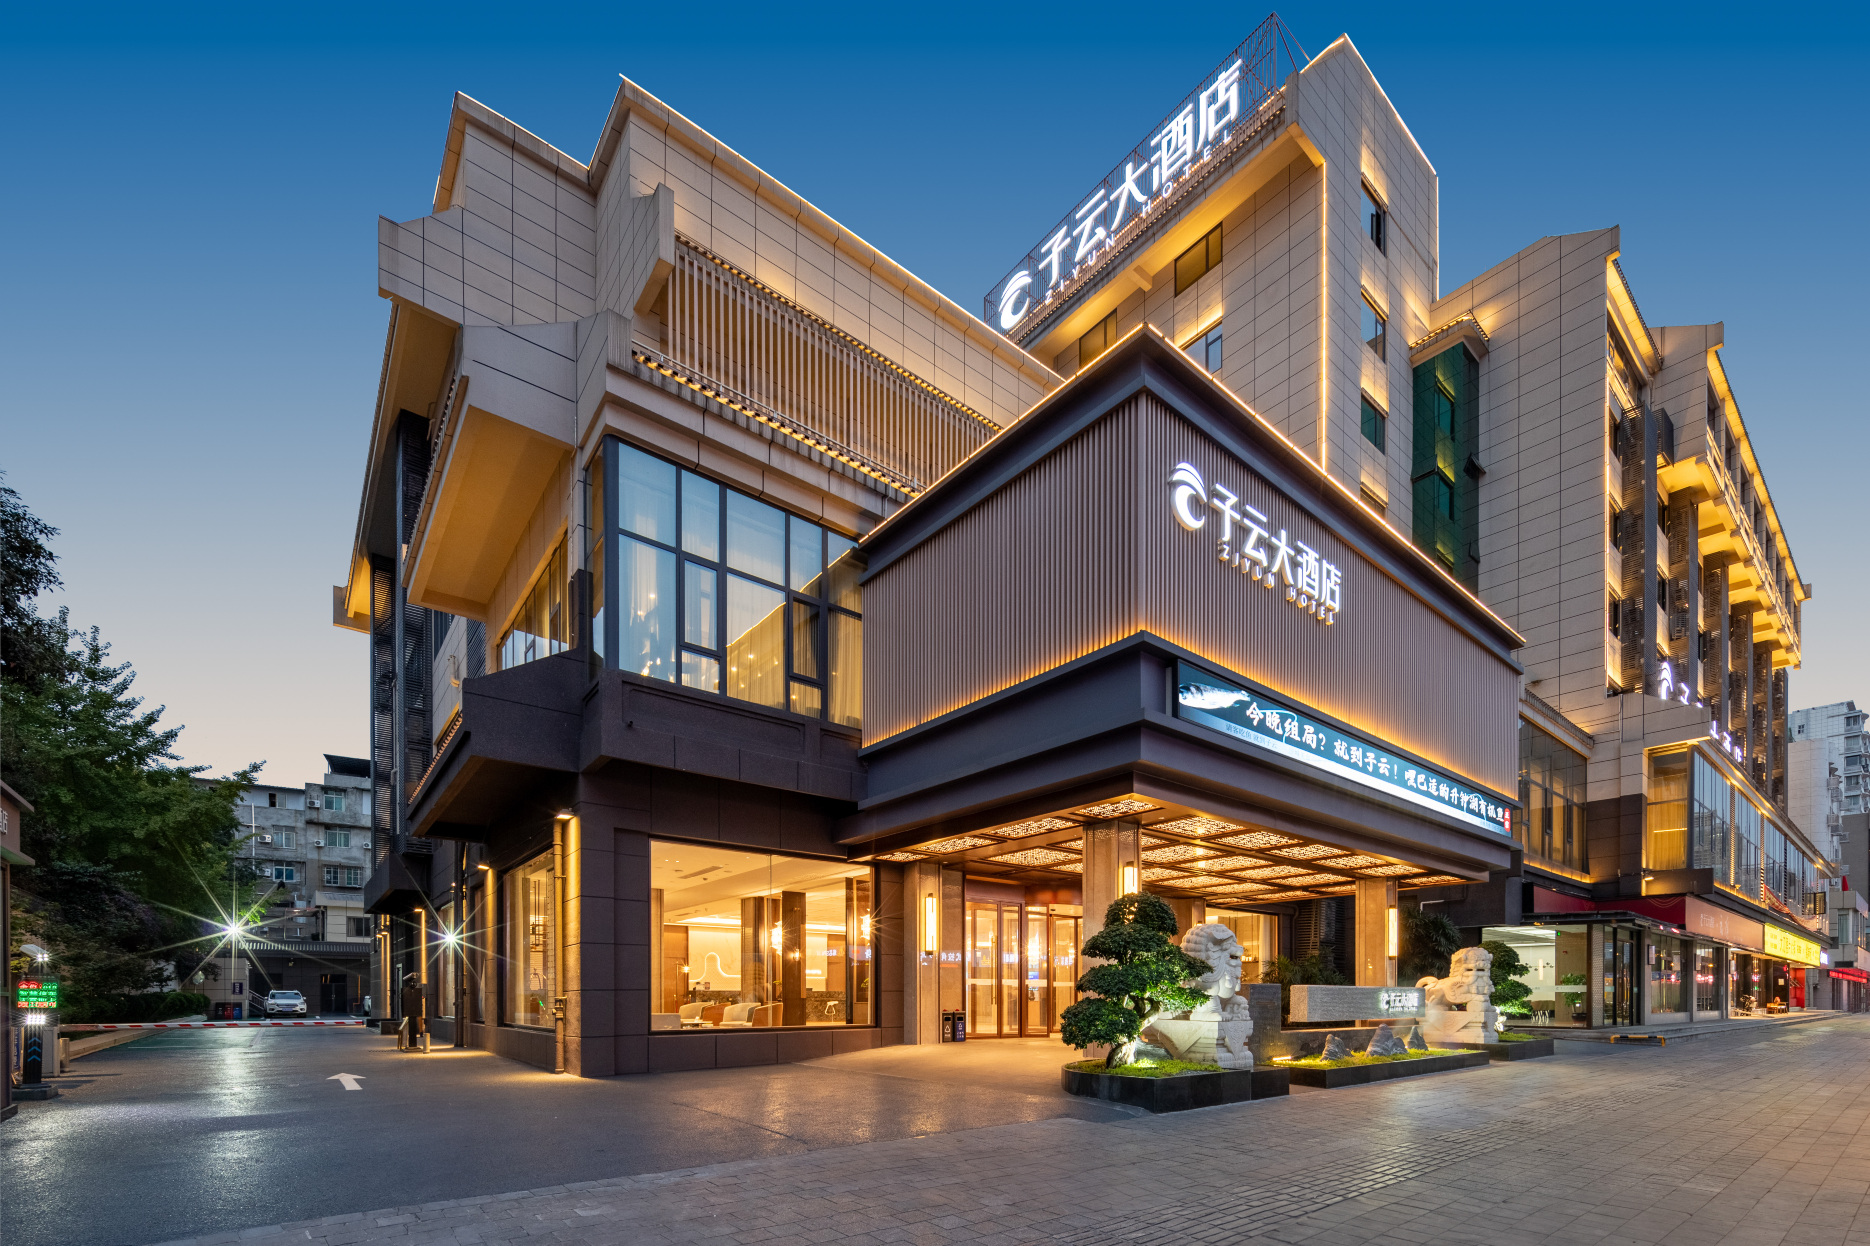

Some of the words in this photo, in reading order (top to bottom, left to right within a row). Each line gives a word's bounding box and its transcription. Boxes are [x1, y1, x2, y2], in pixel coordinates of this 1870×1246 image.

[1038, 58, 1242, 287] 子云大酒店
[1045, 235, 1116, 305] ZIYUN
[1141, 129, 1232, 218] HOTEL
[1209, 483, 1341, 613] 子云大酒店
[1218, 544, 1274, 588] ZIYUN
[1286, 586, 1334, 625] HOTEL
[1246, 701, 1326, 750] 今晚组局？
